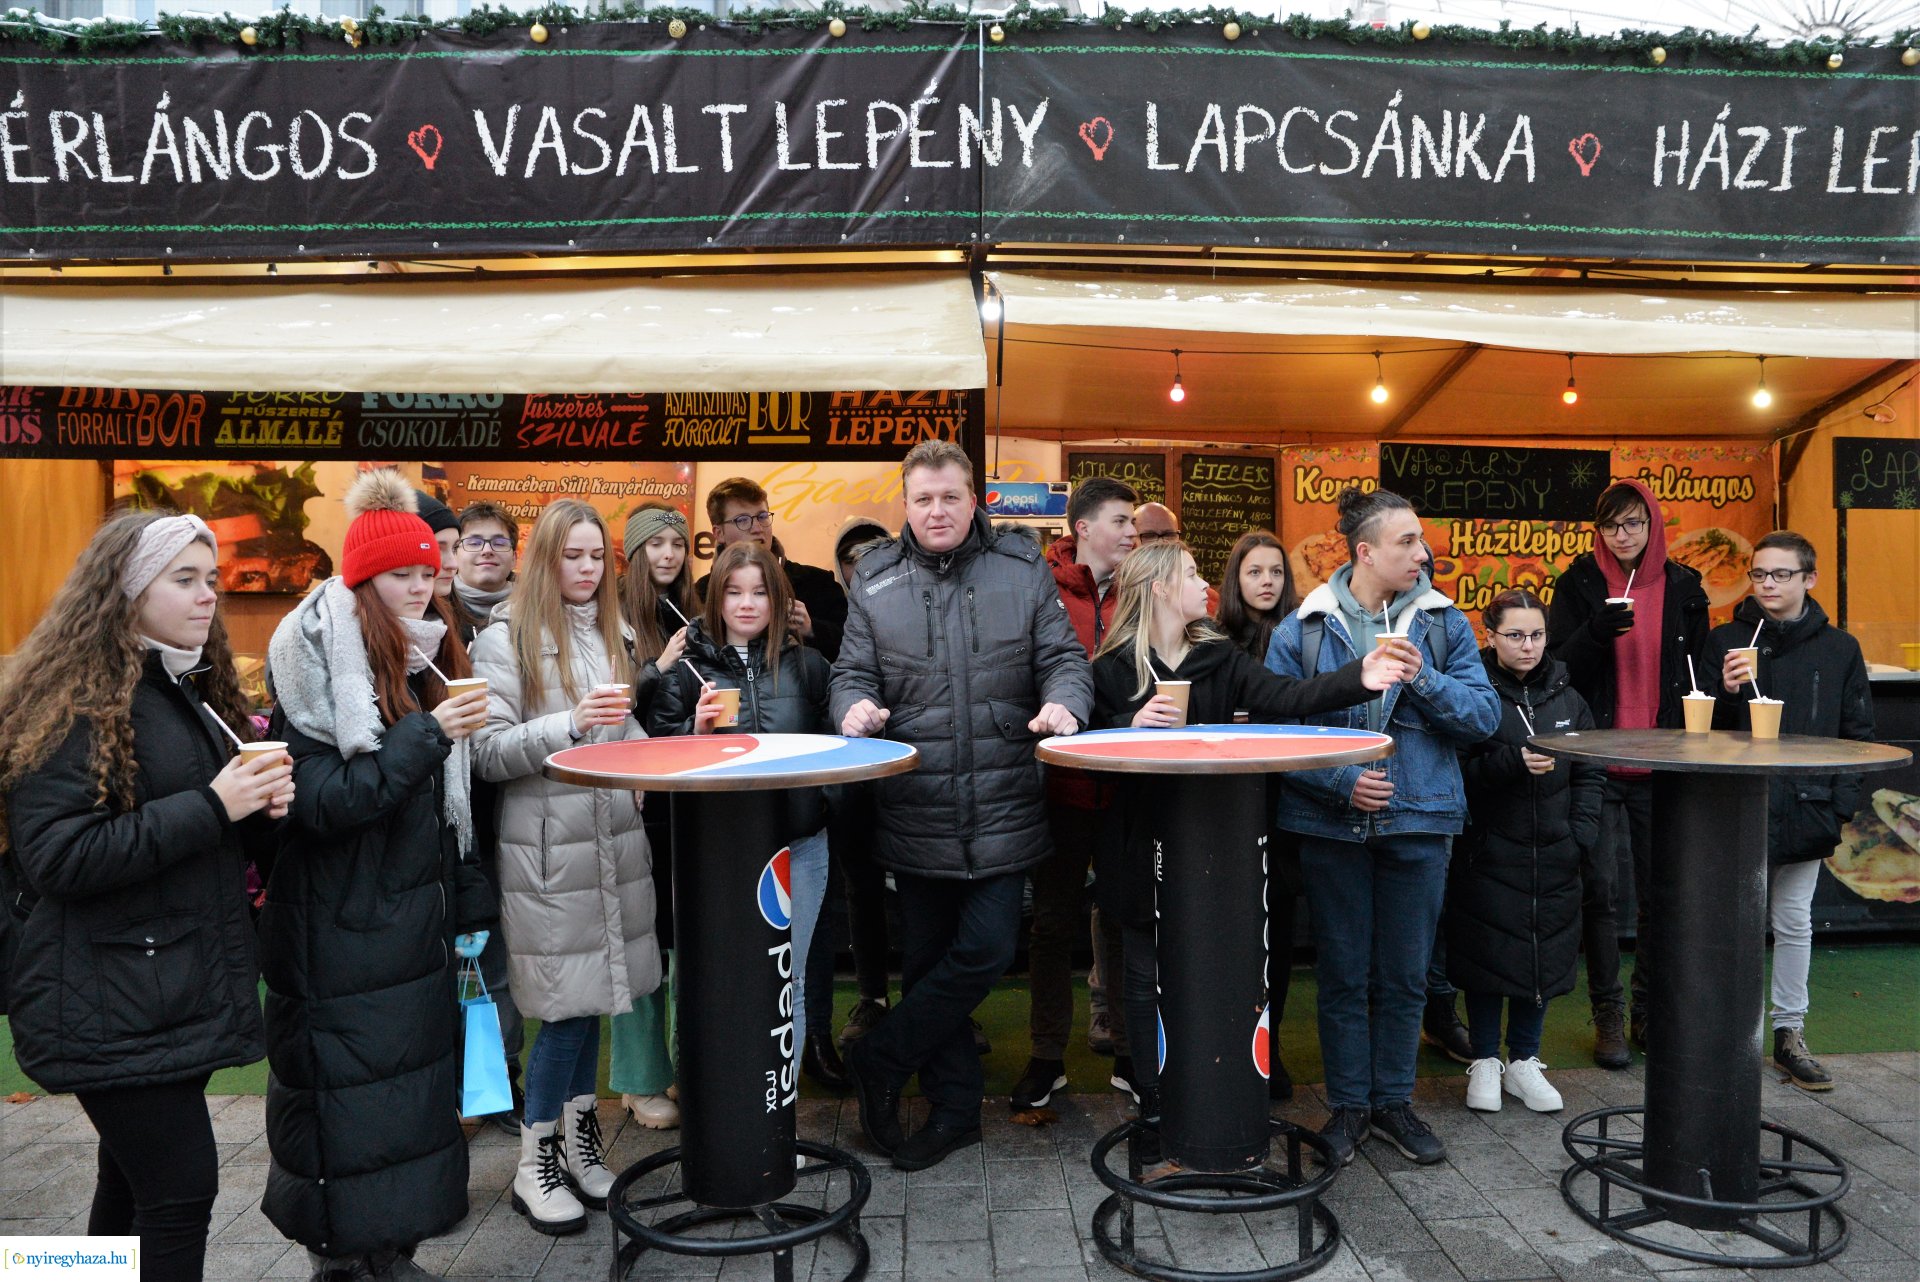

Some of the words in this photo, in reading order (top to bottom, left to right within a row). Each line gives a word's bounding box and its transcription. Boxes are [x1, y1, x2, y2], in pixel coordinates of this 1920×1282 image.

[0, 90, 378, 184] ÉRLÁNGOS
[473, 103, 748, 179] VASALT
[776, 78, 1050, 171] LEPÉNY
[1146, 89, 1536, 183] LAPCSÁNKA
[1653, 102, 1807, 192] HÁZI
[1826, 125, 1920, 196] LE
[57, 412, 136, 446] FORRALT
[136, 392, 207, 447] BOR
[214, 409, 344, 448] ALMALÉ
[357, 410, 502, 448] CSOKOLÁDÉ
[748, 391, 812, 432] BOR
[826, 408, 967, 446] LEPÉNY
[516, 414, 650, 450] SZILVALÉ
[466, 474, 556, 494] Kemencében
[558, 475, 590, 495] Sült
[590, 477, 688, 499] Kenyérlángos
[1189, 457, 1270, 484] ÉTELEK
[1850, 447, 1920, 492] LAP
[1003, 493, 1039, 506] pepsi
[1451, 521, 1595, 562] Házilepén
[768, 941, 796, 1107] pepsi
[765, 1070, 778, 1114] max
